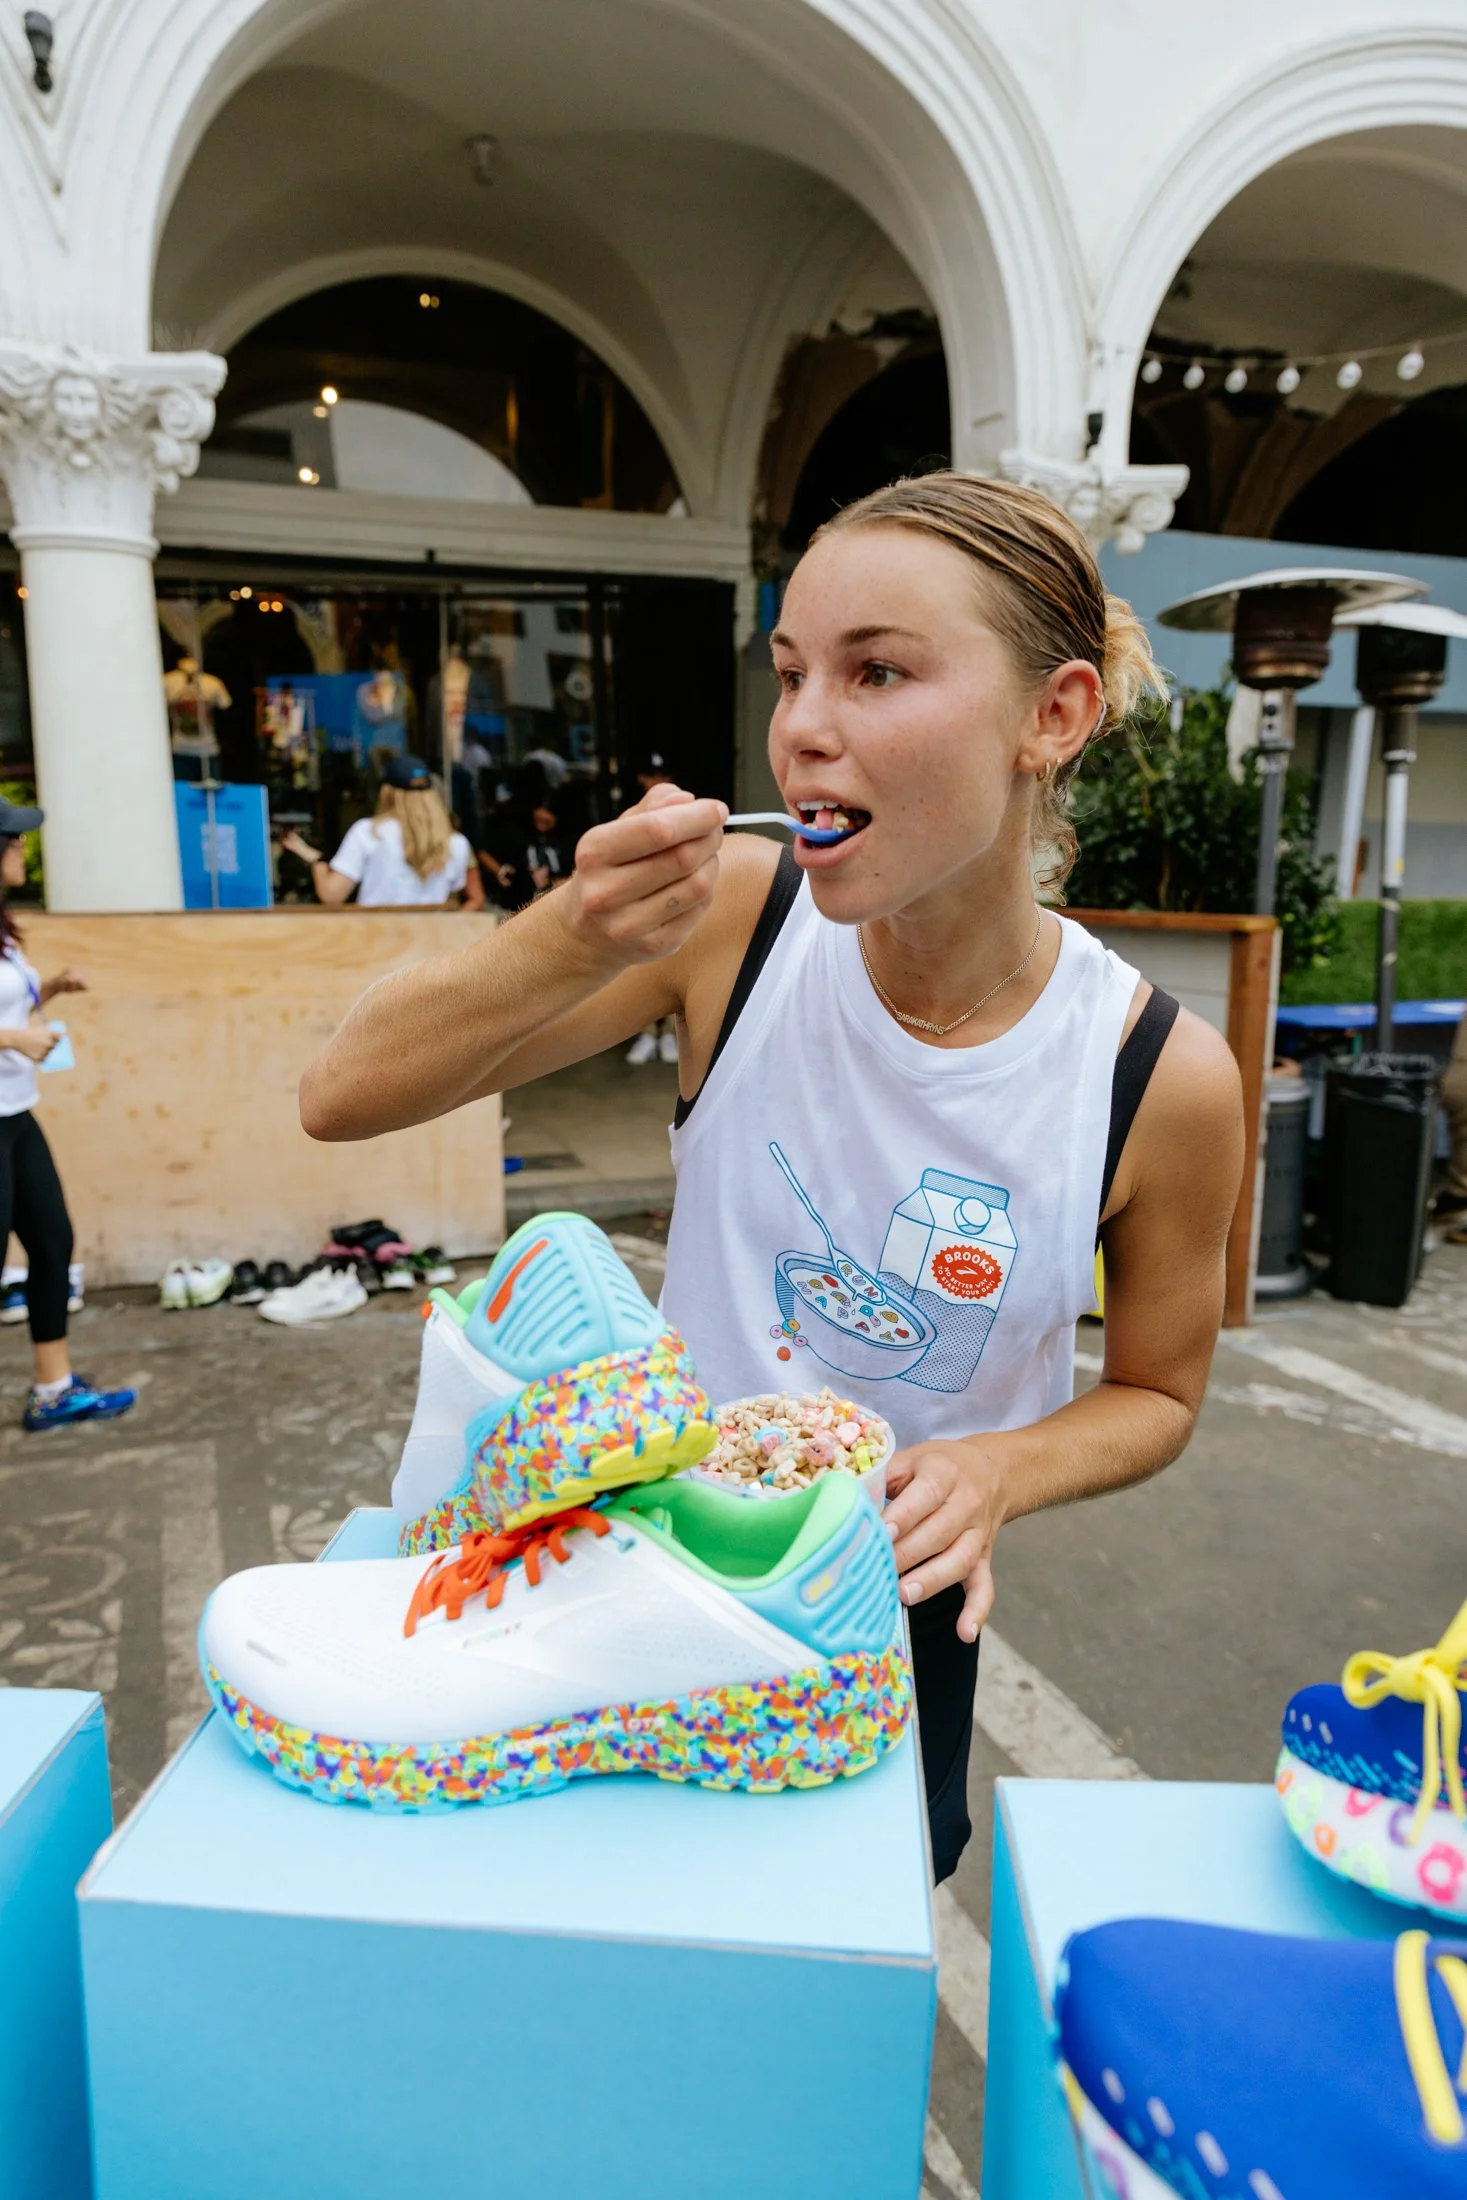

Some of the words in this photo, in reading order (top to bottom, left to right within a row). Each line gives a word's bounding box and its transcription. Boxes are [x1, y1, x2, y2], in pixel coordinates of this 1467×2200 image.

[944, 1251, 995, 1275] BROOKS
[841, 1263, 878, 1298] RUN
[937, 1265, 944, 1275] TO
[941, 1276, 960, 1292] START
[944, 1267, 952, 1277] NO
[950, 1277, 973, 1289] BETTER
[975, 1278, 988, 1288] WAY
